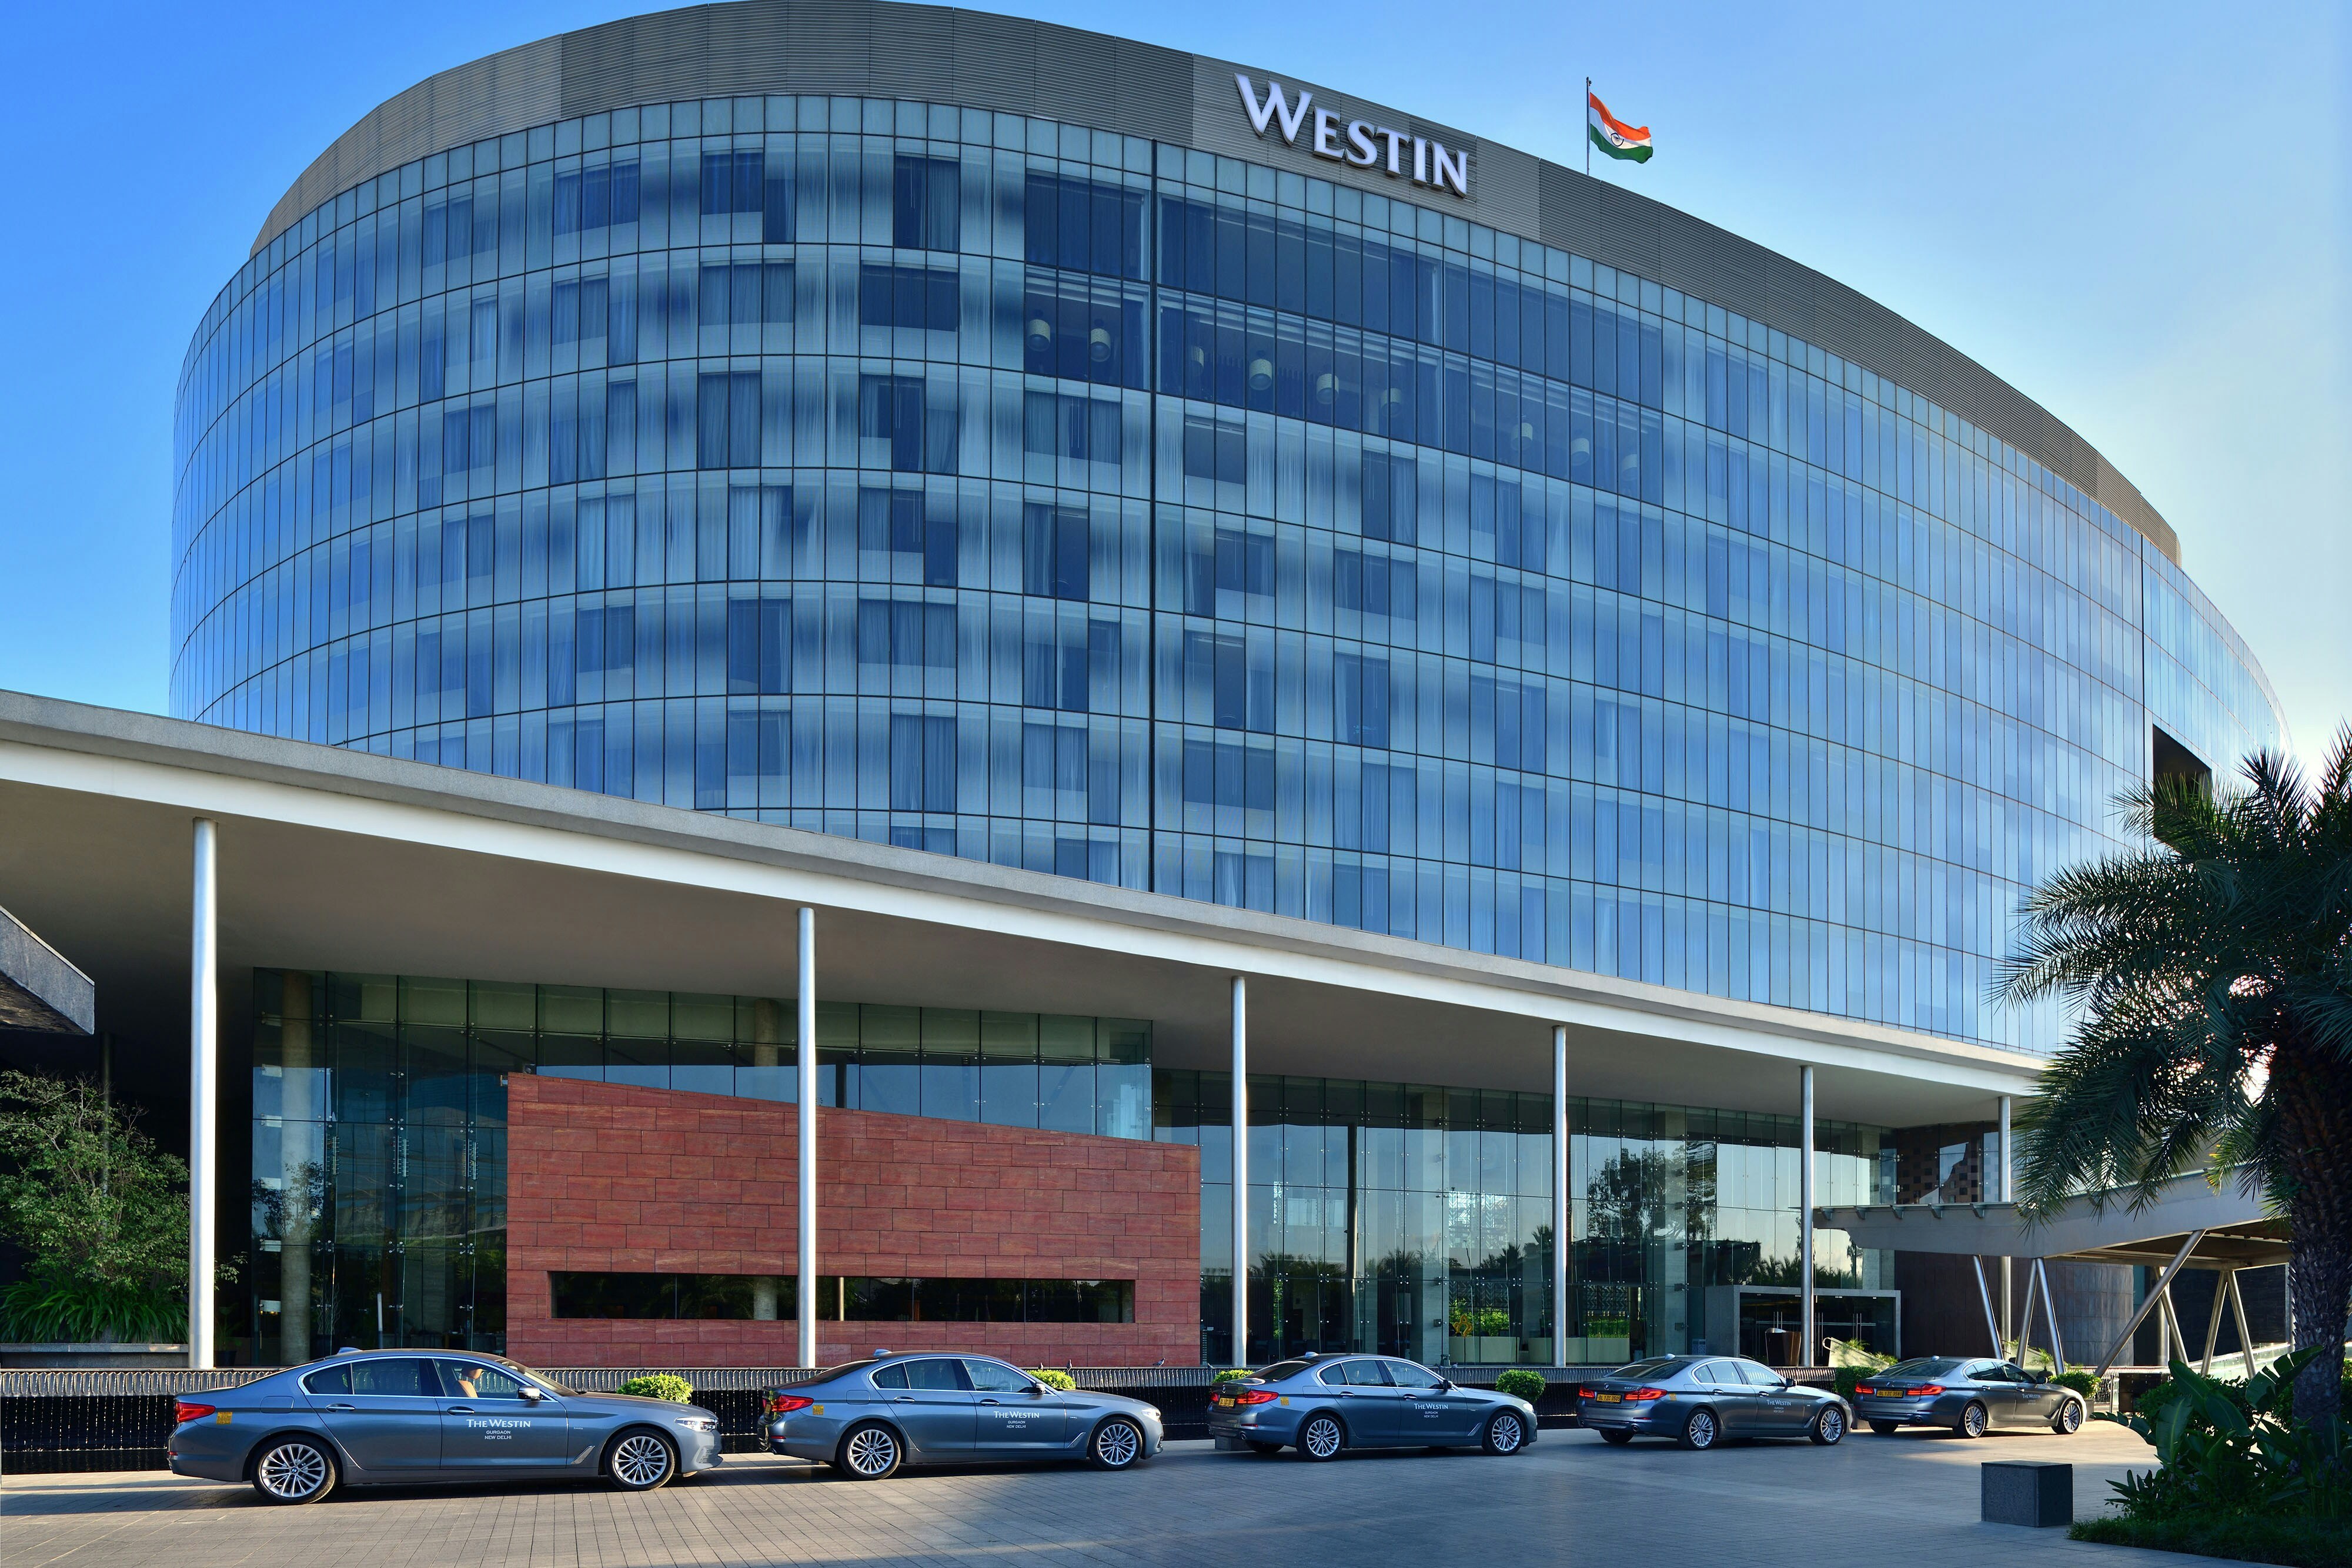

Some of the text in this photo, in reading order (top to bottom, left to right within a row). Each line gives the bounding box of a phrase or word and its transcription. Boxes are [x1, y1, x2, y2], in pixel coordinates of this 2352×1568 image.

[1234, 73, 1469, 198] WESTIN
[466, 1419, 531, 1427] THE WESTIN
